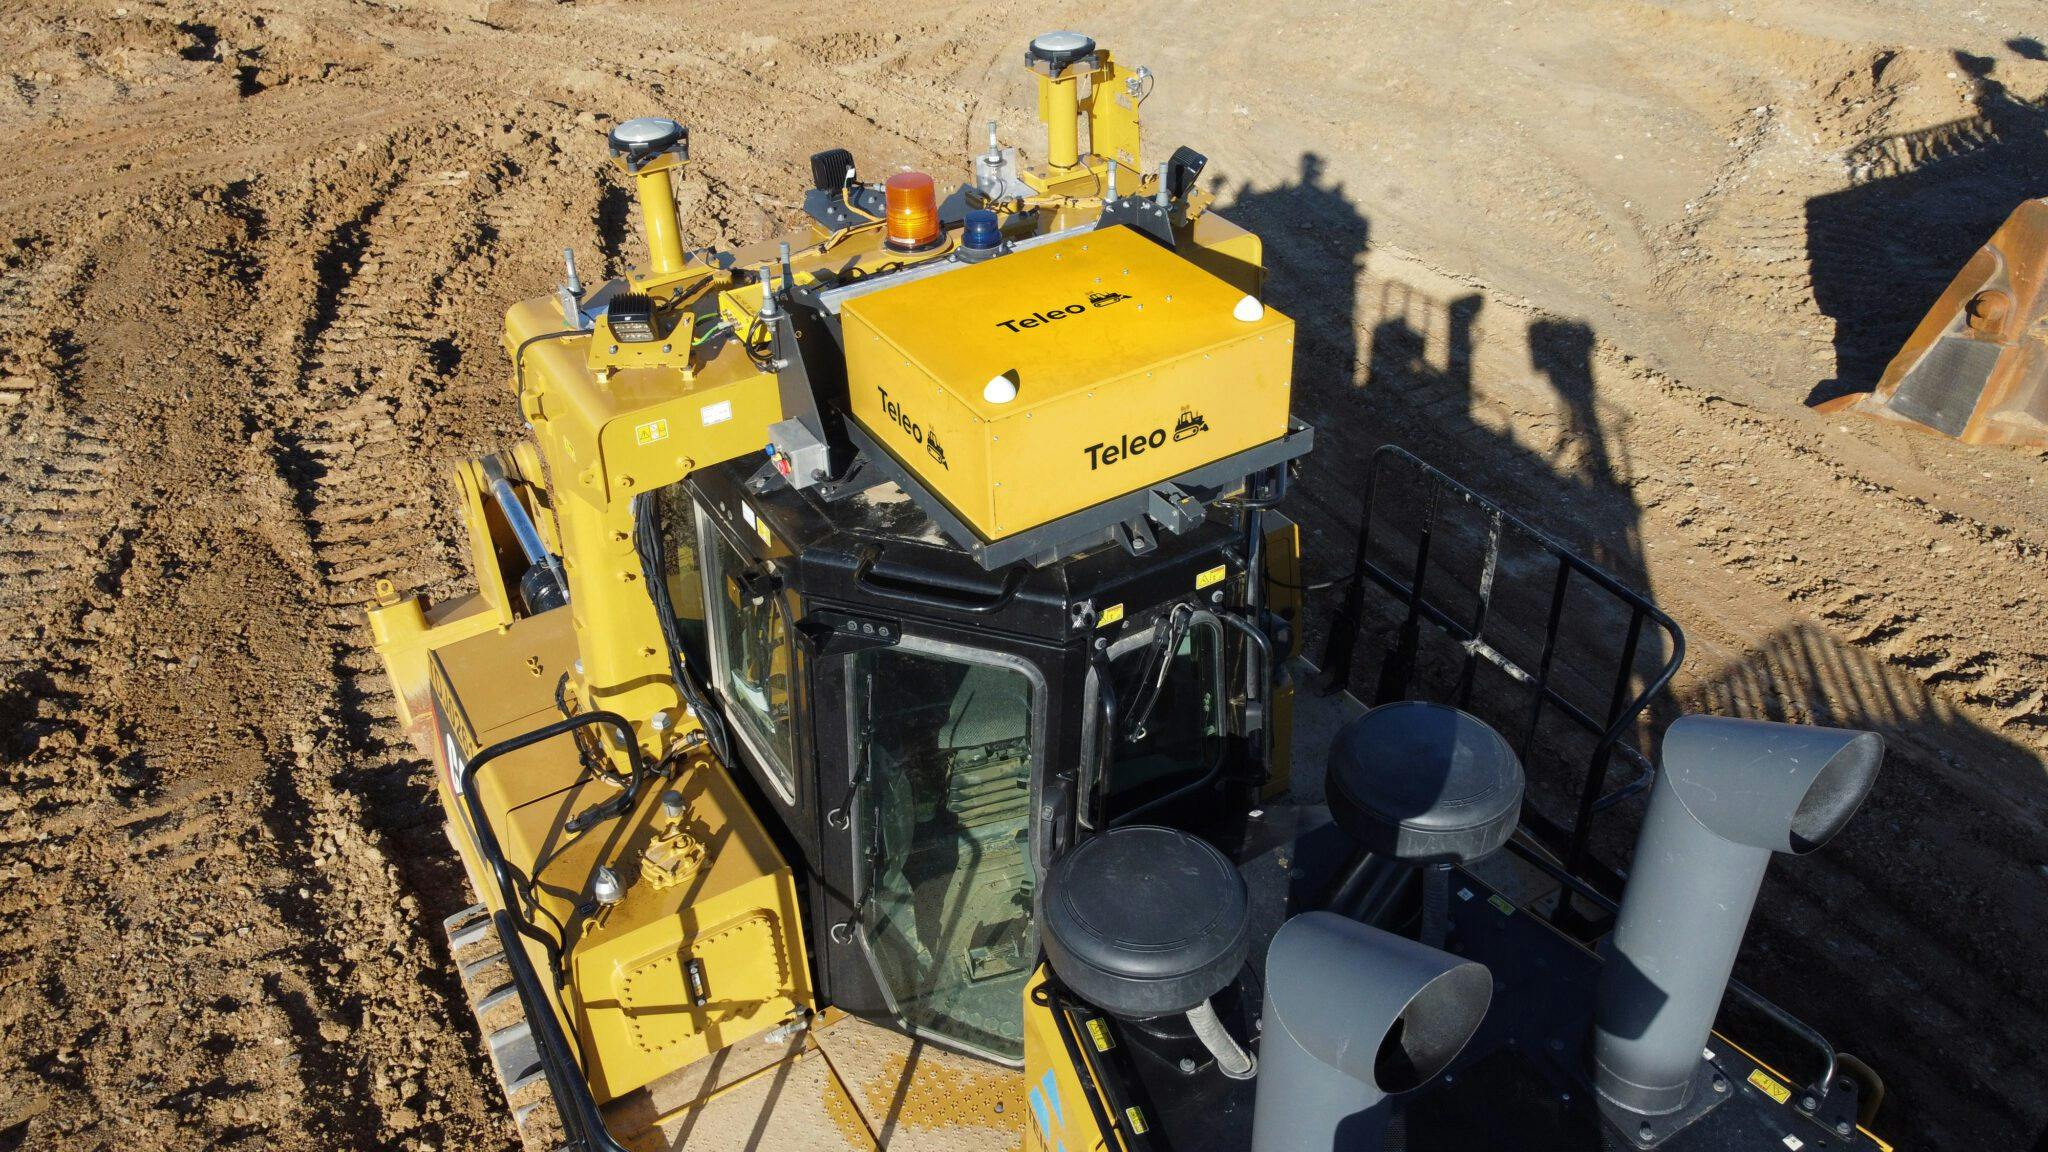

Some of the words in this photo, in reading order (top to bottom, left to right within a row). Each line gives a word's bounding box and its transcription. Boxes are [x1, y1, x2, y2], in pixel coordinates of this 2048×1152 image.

[995, 302, 1086, 334] Teleo
[877, 385, 924, 445] Teleo
[1083, 427, 1168, 472] Teleo
